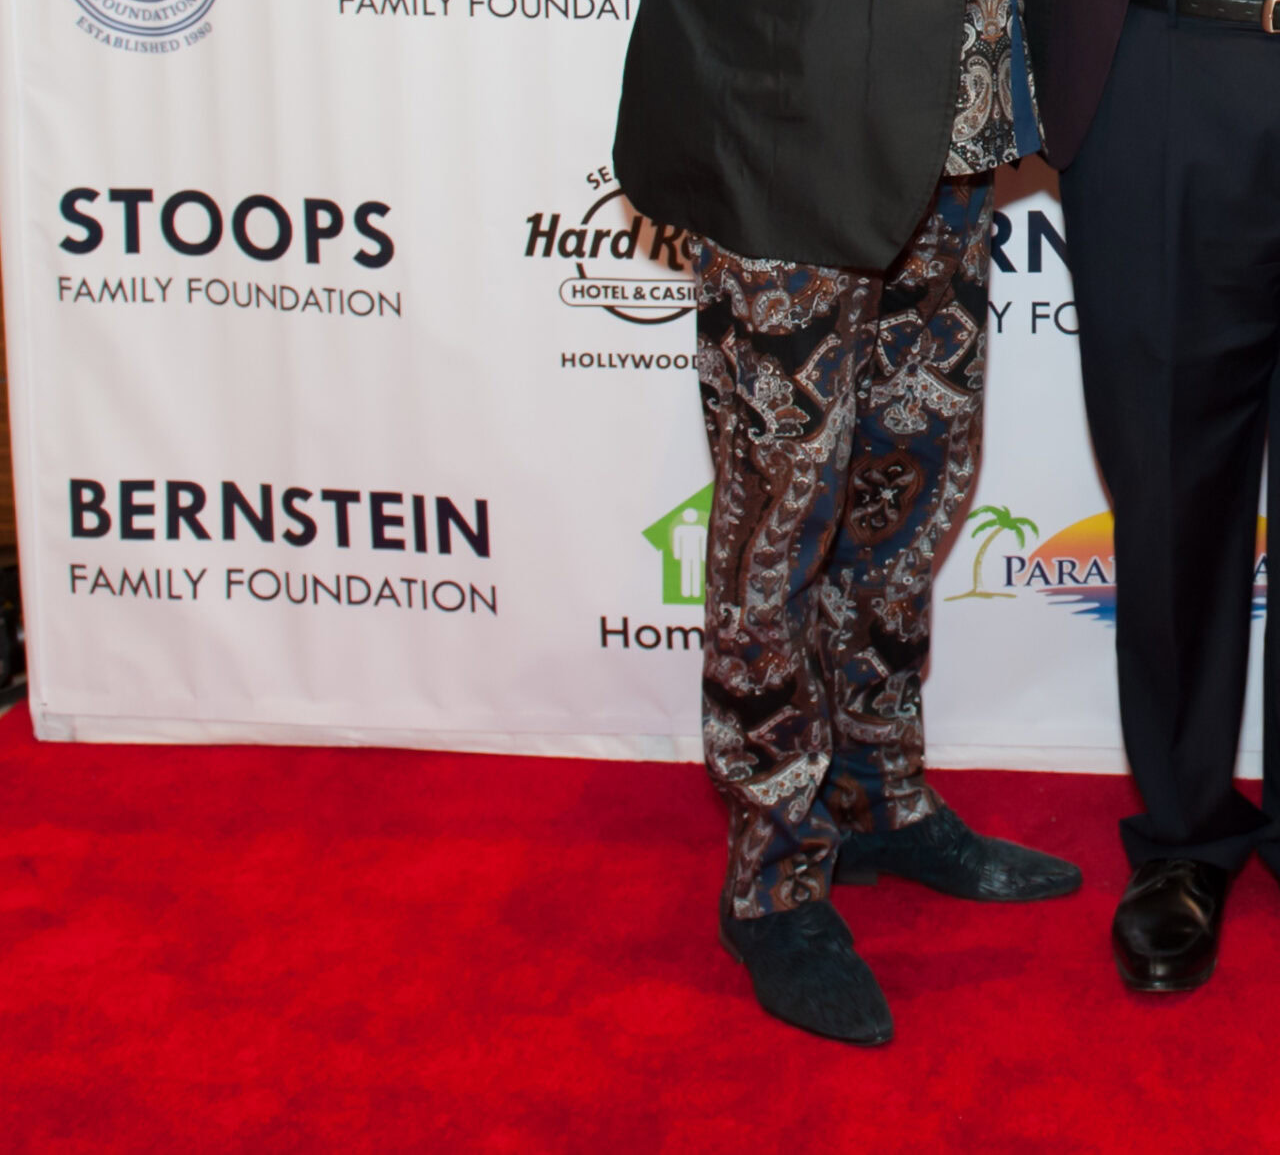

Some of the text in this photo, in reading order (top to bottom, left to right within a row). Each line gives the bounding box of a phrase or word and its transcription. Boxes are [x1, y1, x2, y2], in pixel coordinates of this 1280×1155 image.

[76, 15, 213, 54] ESTABLISHED 1980
[58, 187, 395, 269] STOOPS
[525, 213, 643, 259] Hard
[57, 276, 401, 317] FAMILY FOUNDATION
[572, 284, 698, 301] HOTEL & CASI
[561, 353, 698, 369] HOLLYWOO
[69, 478, 491, 559] BERNSTEIN
[69, 563, 497, 616] FAMILY FOUNDATION
[1004, 555, 1114, 586] PARA
